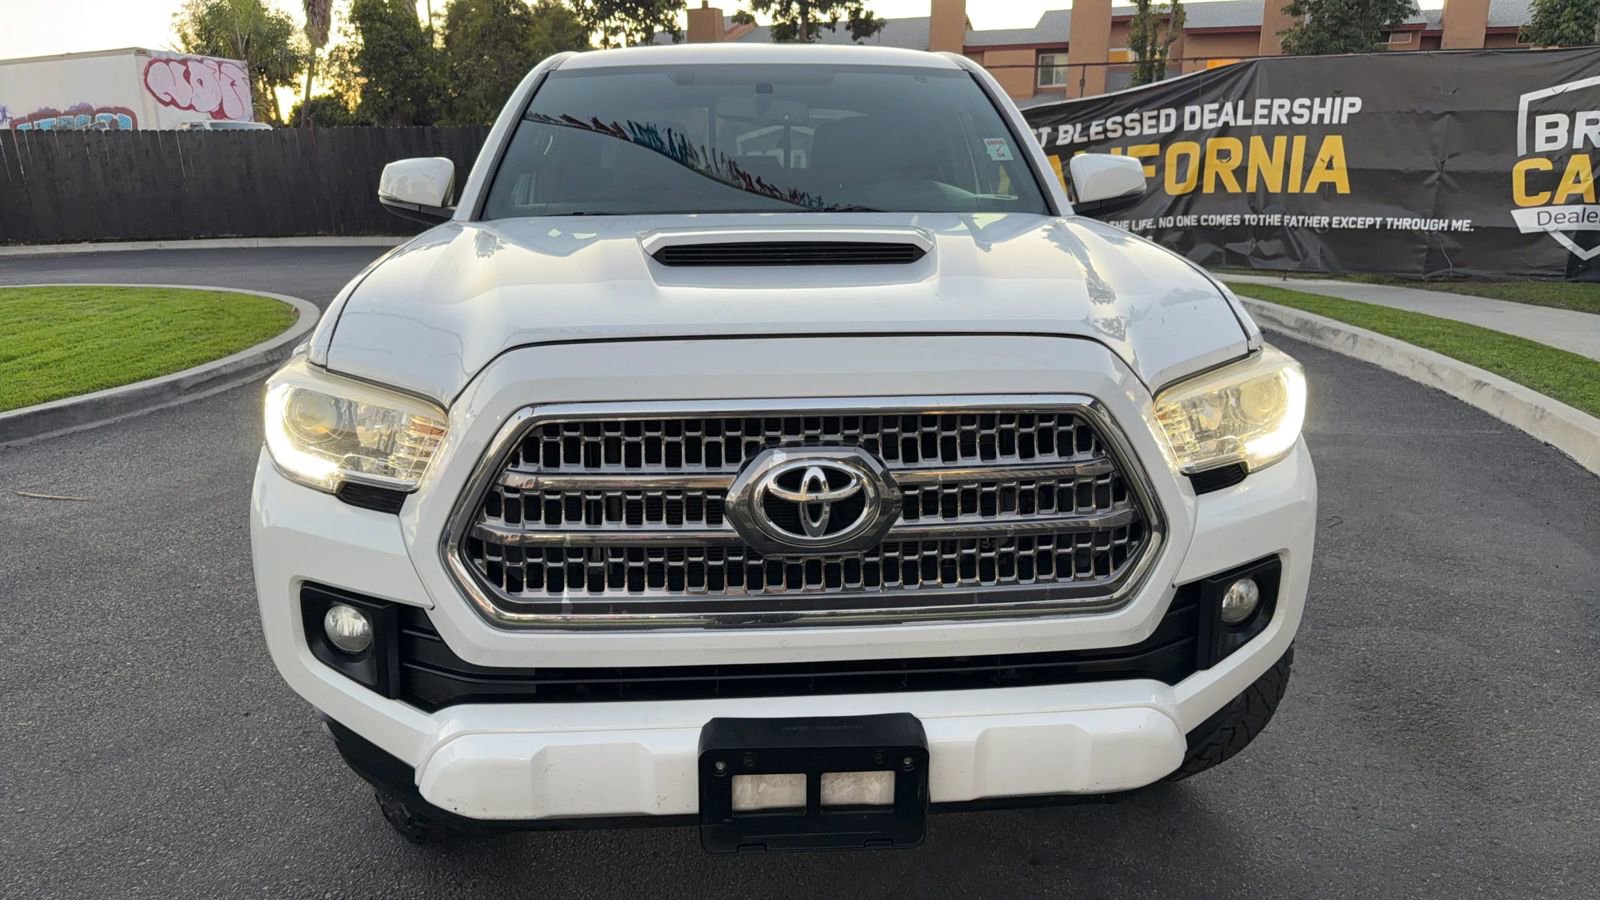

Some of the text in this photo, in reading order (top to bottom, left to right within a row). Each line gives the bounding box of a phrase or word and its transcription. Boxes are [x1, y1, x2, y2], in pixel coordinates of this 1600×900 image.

[1056, 108, 1177, 146] BLESSED
[1183, 97, 1363, 132] DEALERSHIP
[1534, 110, 1600, 152] BR
[1047, 135, 1351, 196] FORNIA
[1512, 154, 1600, 207] CA
[1131, 218, 1156, 231] LIFE.
[1158, 216, 1174, 229] NO
[1176, 215, 1198, 227] ONE
[1200, 214, 1241, 226] COMES
[1283, 215, 1330, 228] FATHER
[1331, 216, 1383, 229] EXCEPT
[1385, 217, 1448, 231] THROUGH
[1450, 218, 1475, 232] ME.
[1537, 207, 1600, 226] Deale
